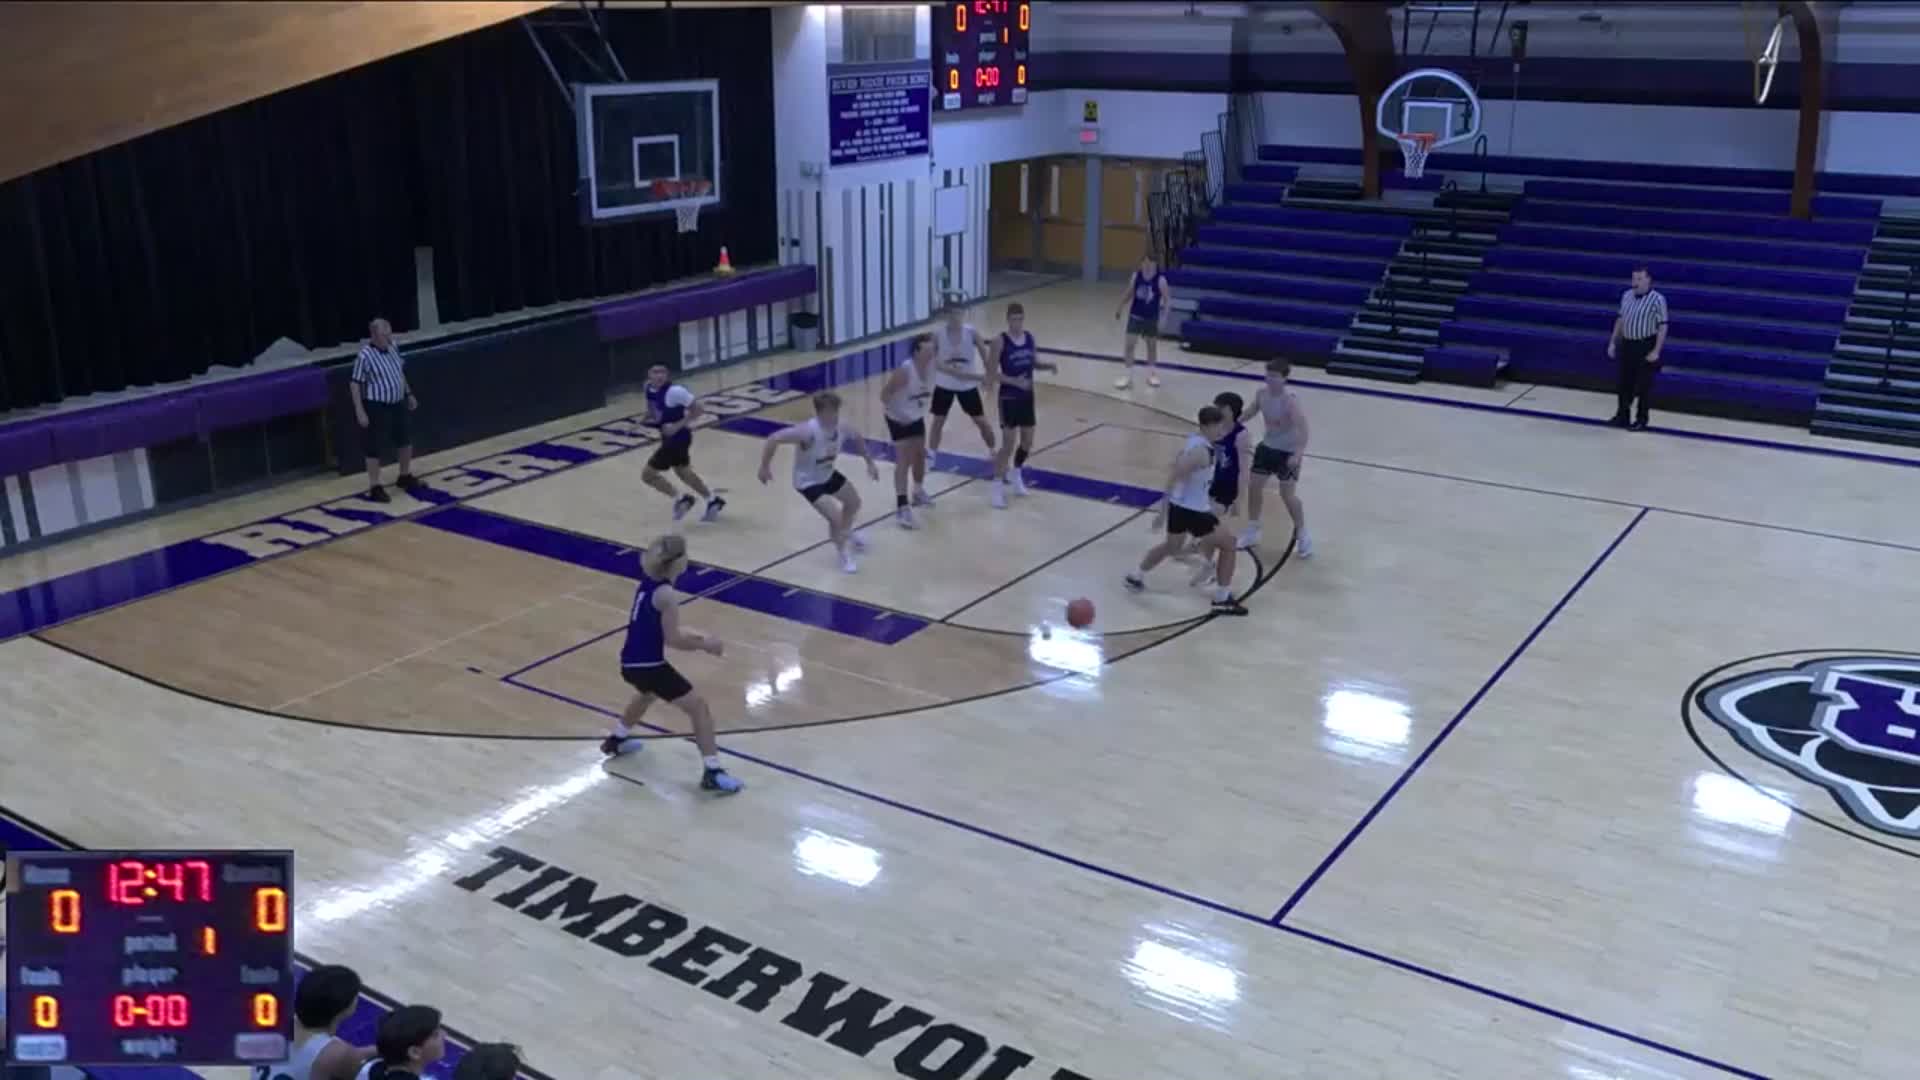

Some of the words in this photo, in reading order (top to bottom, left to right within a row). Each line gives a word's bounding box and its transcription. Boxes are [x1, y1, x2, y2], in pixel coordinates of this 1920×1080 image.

[956, 4, 967, 32] 0
[1019, 3, 1030, 31] 0
[1003, 27, 1009, 44] 1
[950, 68, 959, 90] 0
[976, 67, 999, 88] 0-00
[1017, 65, 1026, 85] 0
[202, 450, 570, 559] RIVER
[556, 384, 796, 459] RIGE
